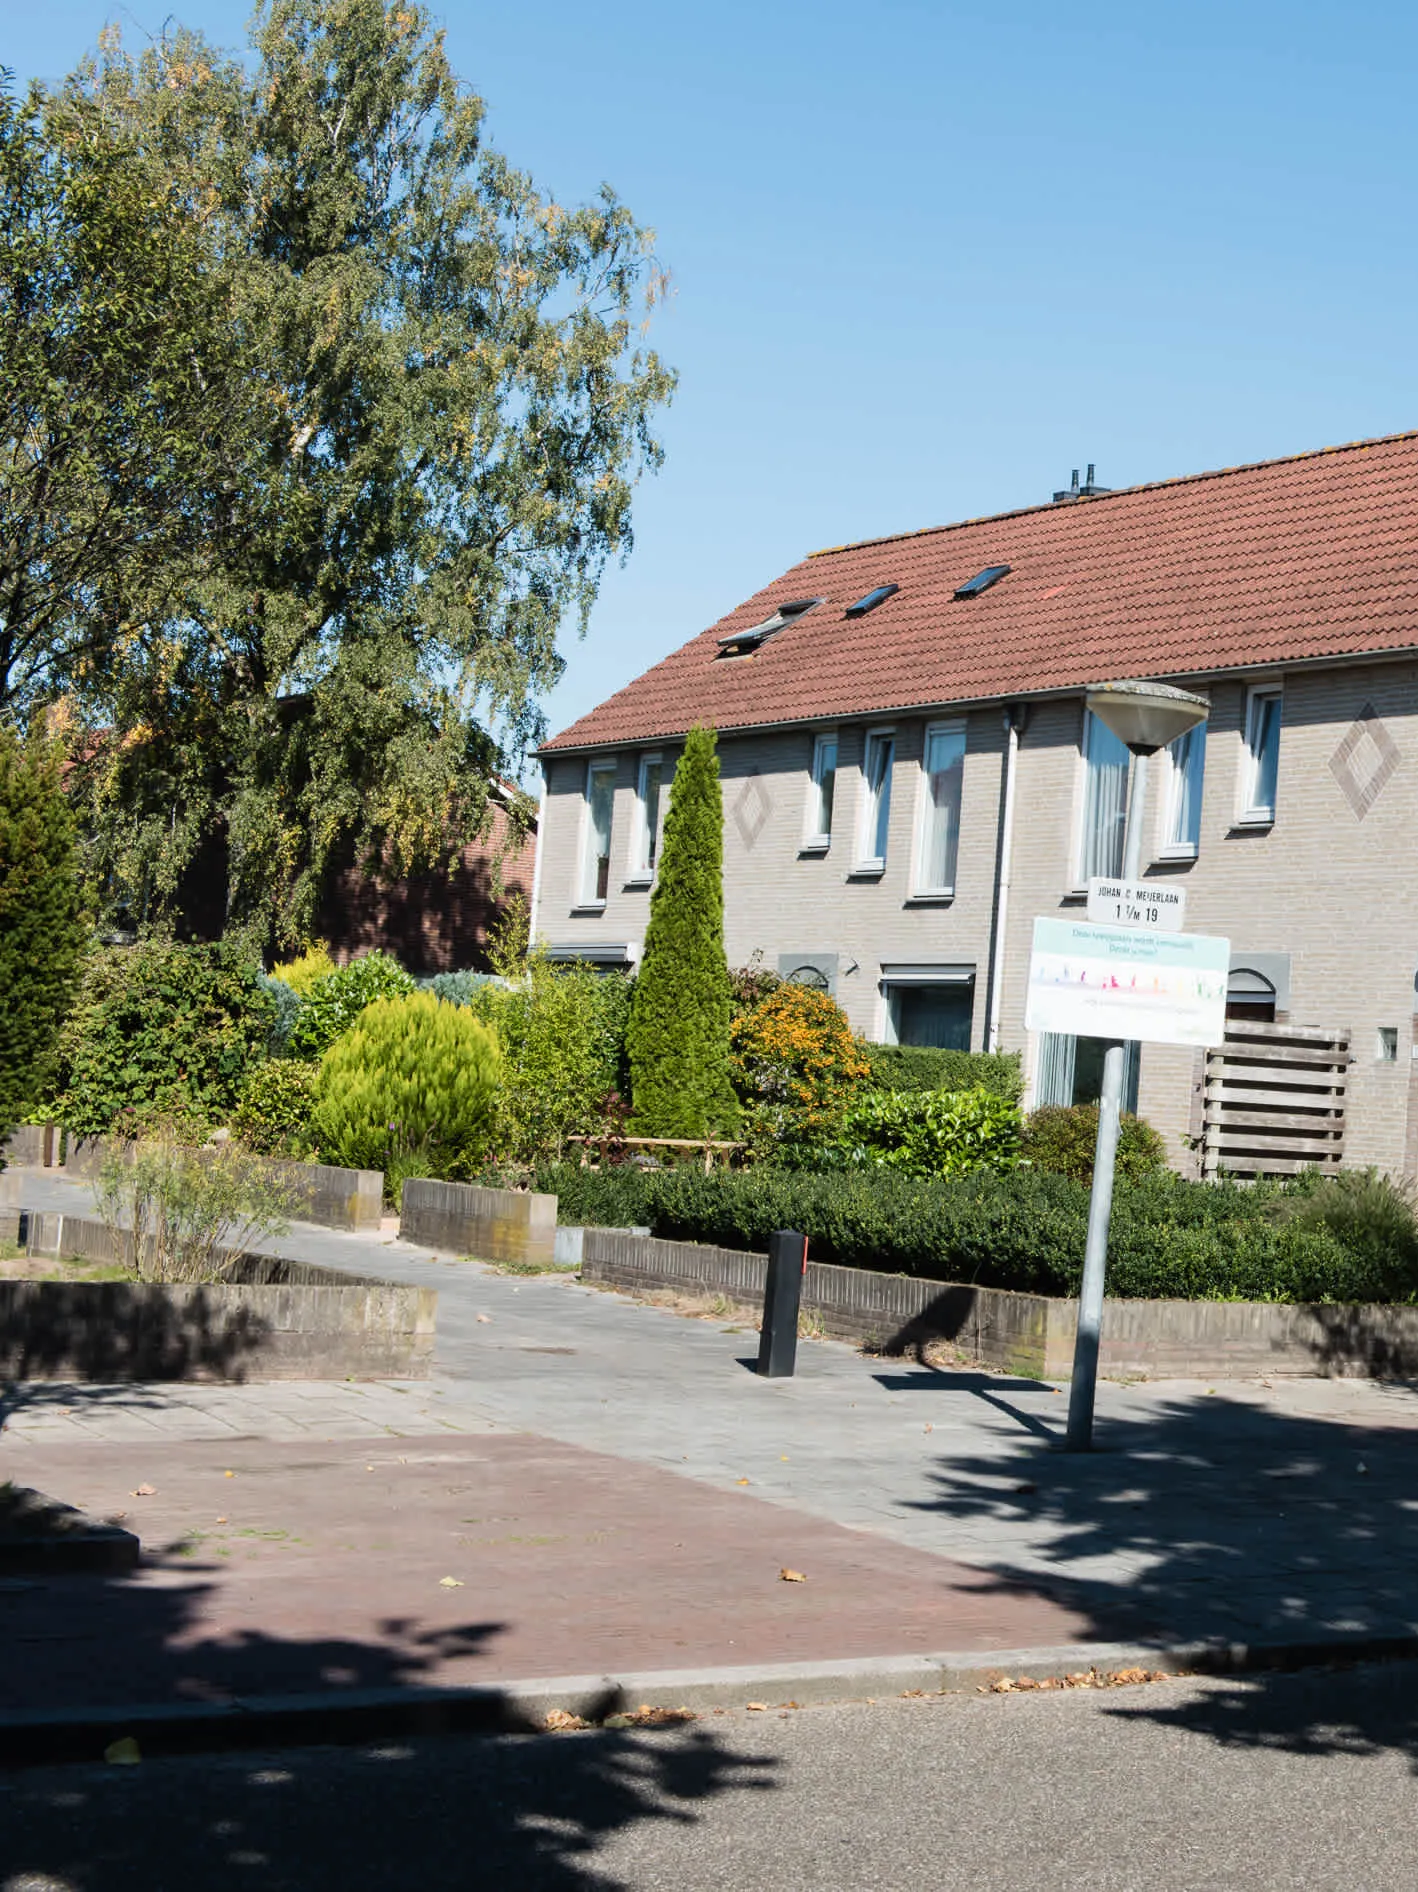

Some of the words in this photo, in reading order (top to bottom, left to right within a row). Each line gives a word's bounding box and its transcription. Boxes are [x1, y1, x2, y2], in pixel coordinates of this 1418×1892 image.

[1098, 887, 1121, 898] JOHAN
[1126, 889, 1131, 899] C
[1116, 905, 1121, 919] 1
[1147, 908, 1158, 922] 19
